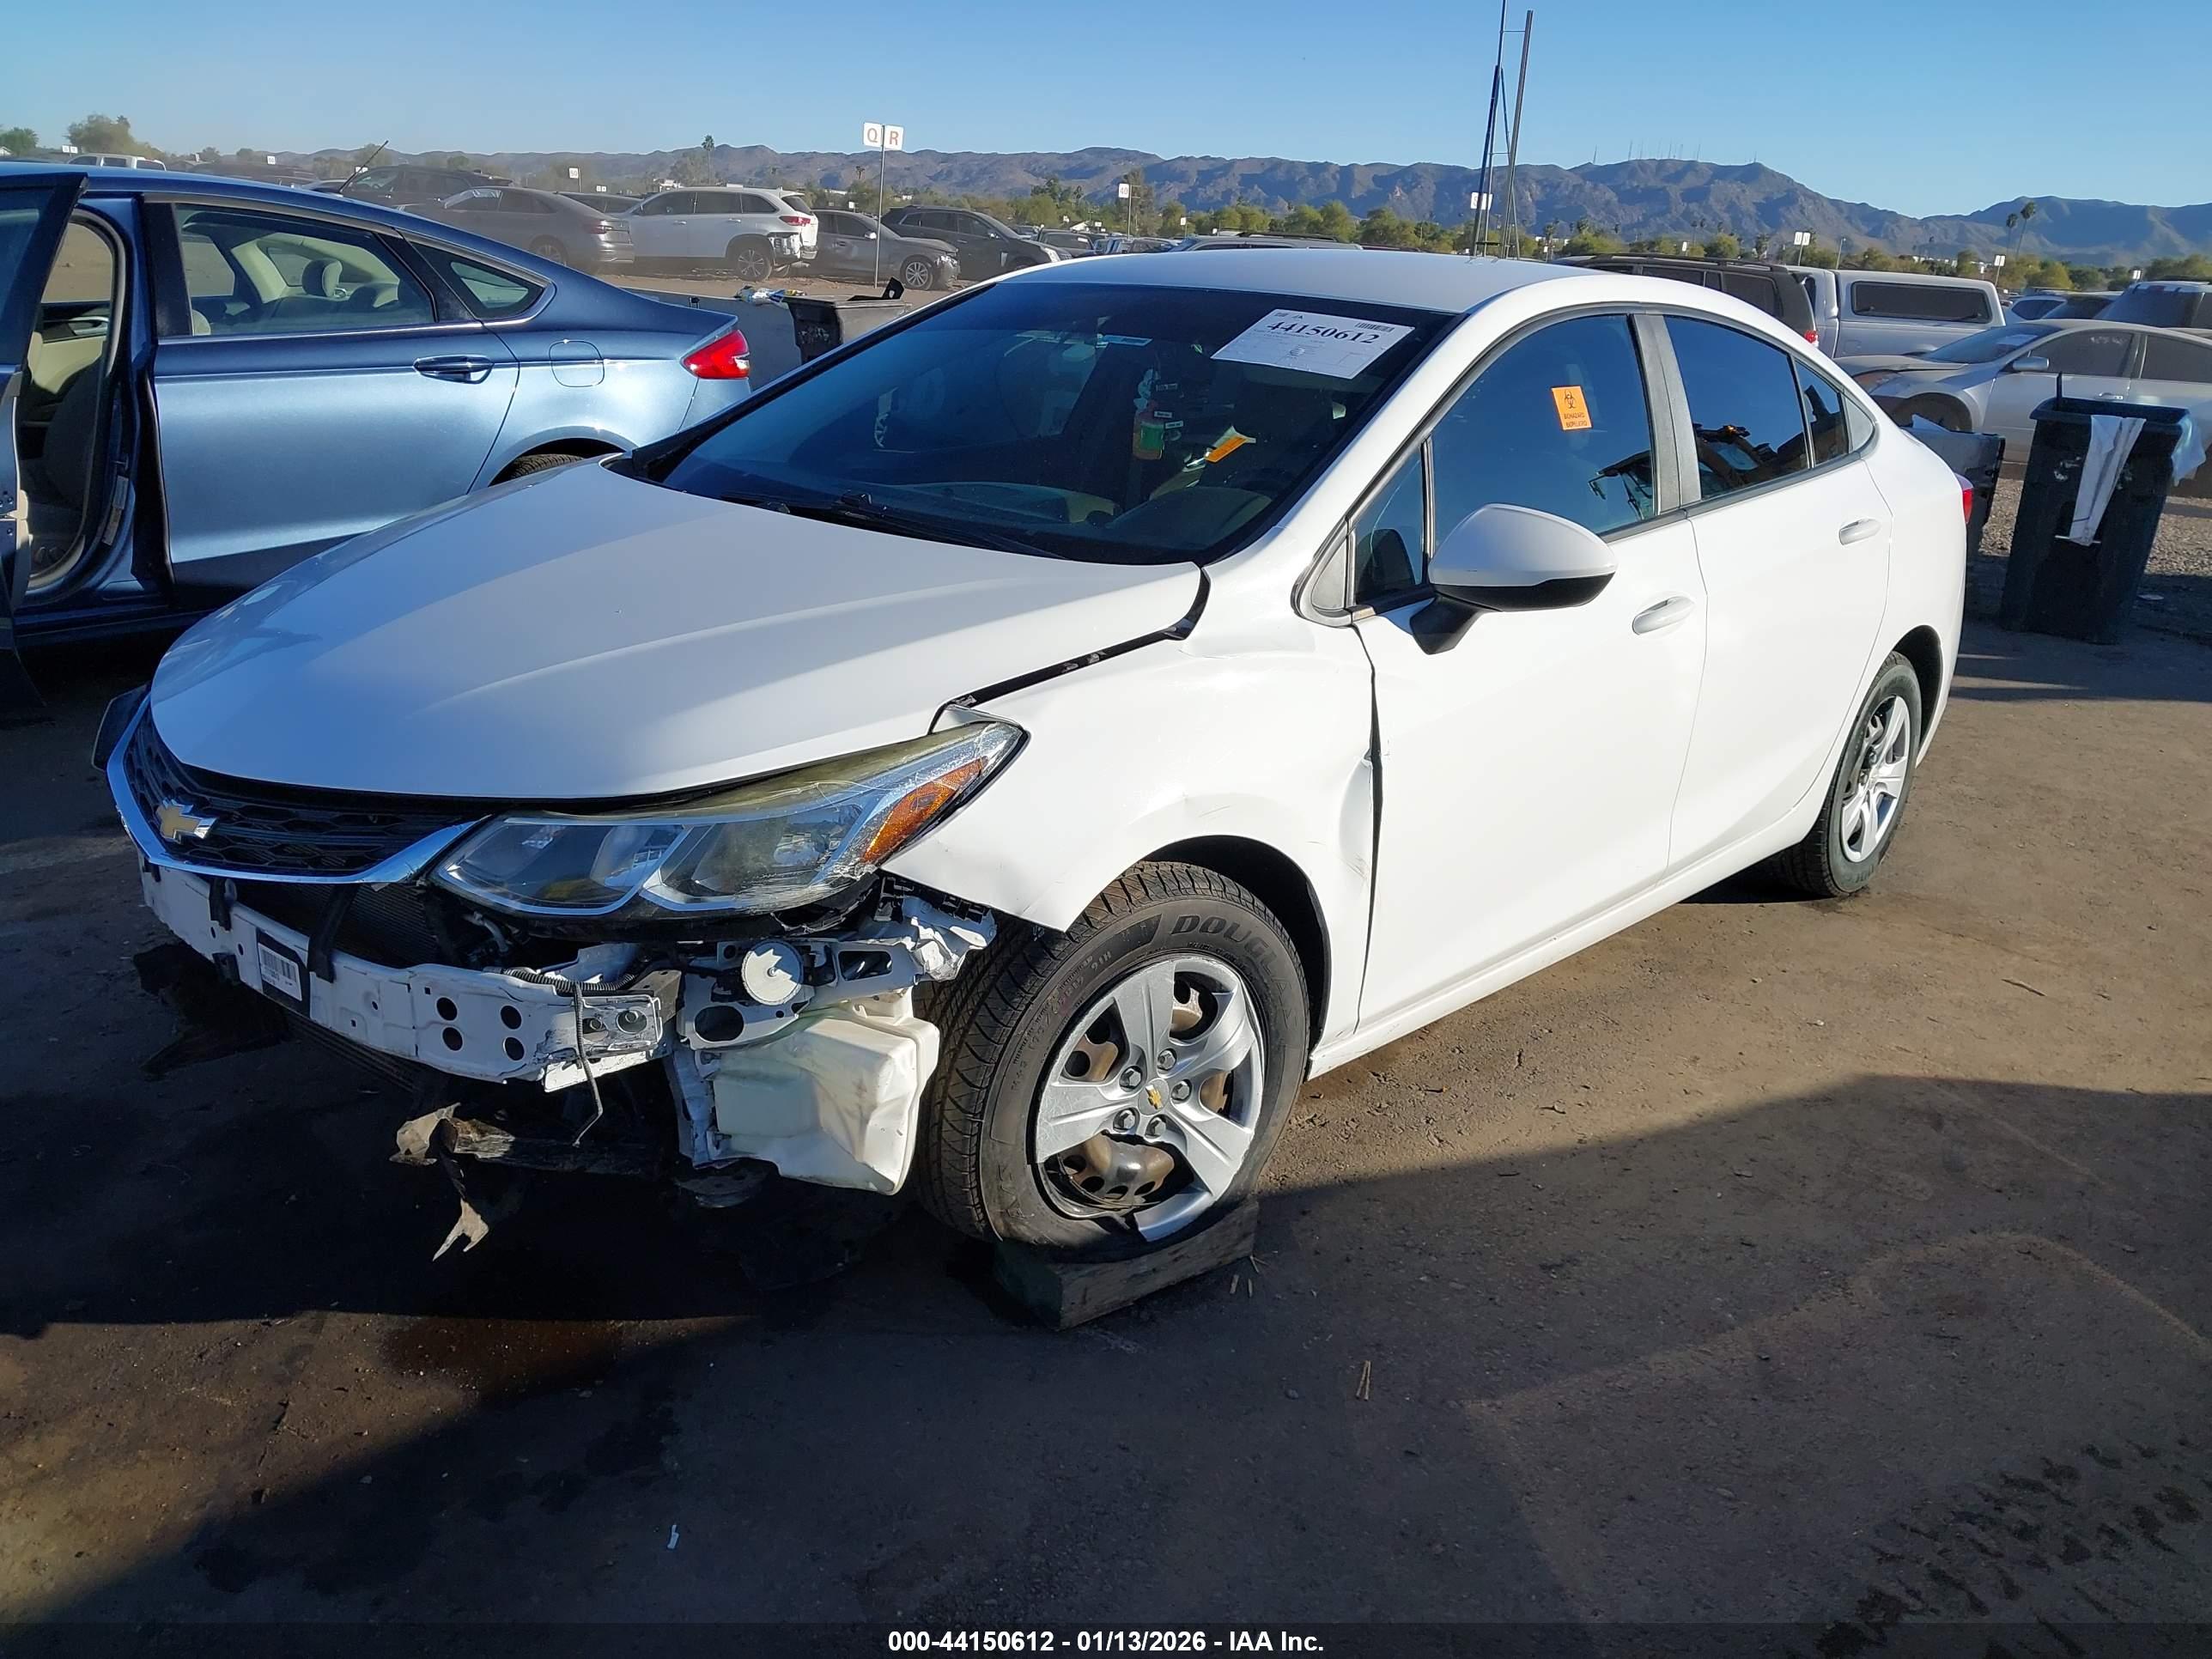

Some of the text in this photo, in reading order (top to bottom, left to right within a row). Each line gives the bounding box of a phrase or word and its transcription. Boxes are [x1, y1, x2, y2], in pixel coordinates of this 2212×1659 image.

[866, 127, 899, 146] Q R
[1119, 186, 1128, 195] 40
[1267, 321, 1380, 344] 44150612
